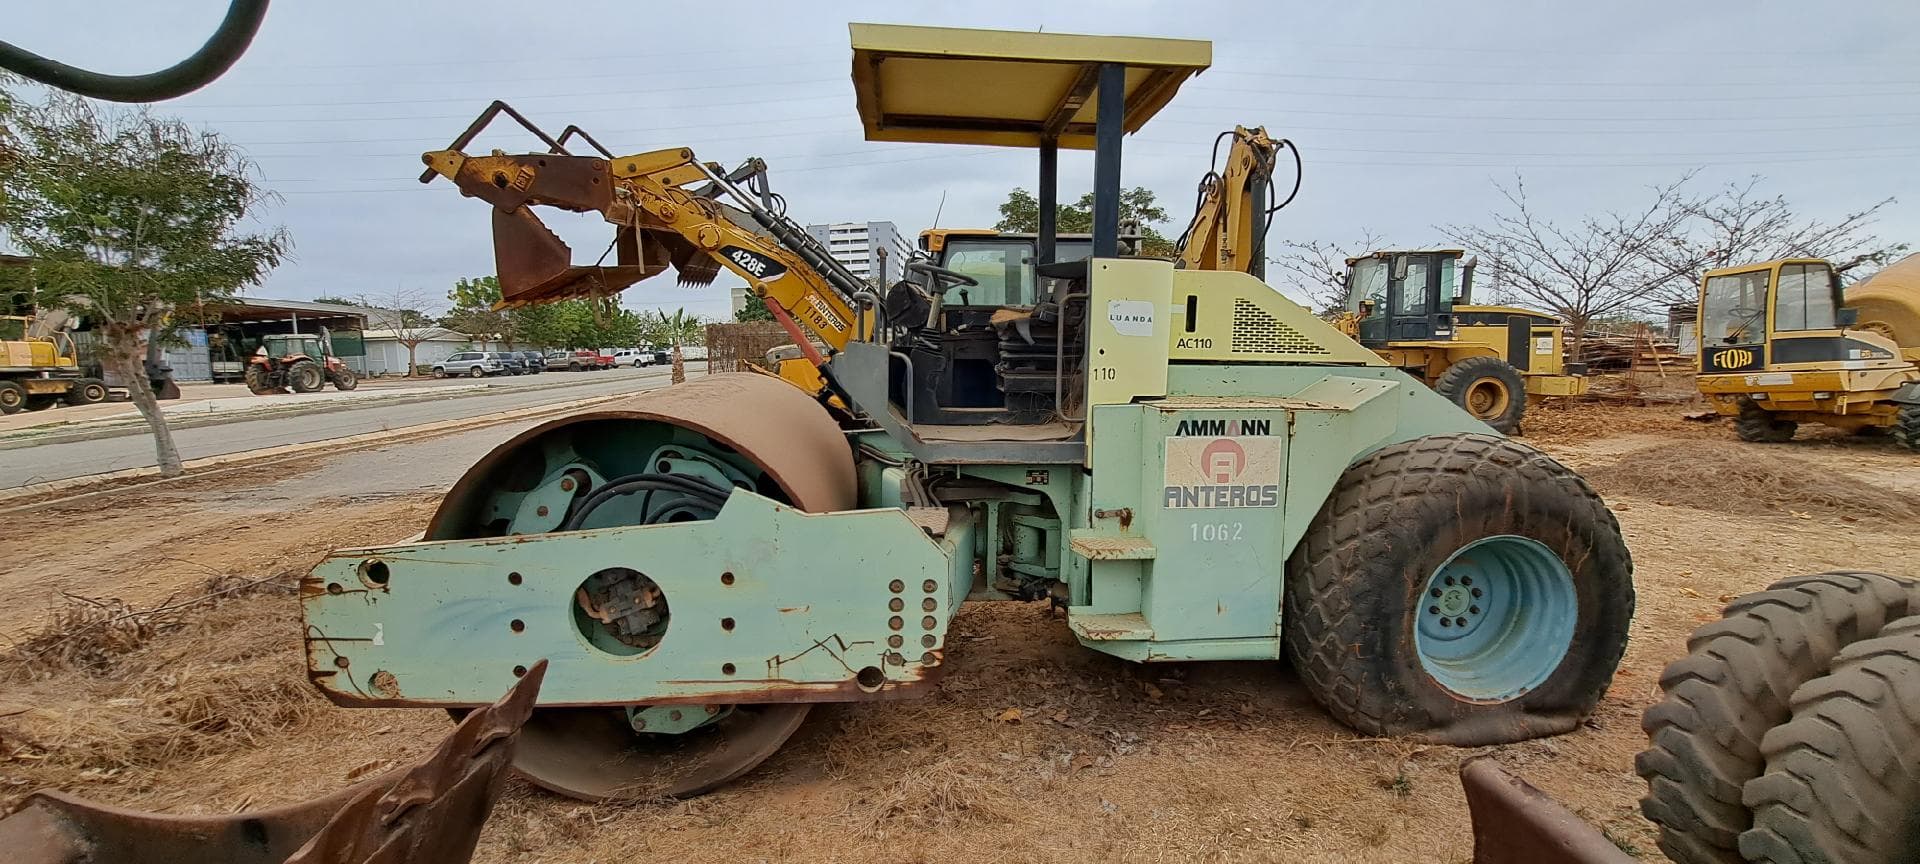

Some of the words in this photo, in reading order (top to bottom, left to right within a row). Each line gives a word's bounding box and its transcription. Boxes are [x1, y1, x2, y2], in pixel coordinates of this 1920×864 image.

[732, 250, 766, 277] 428E
[804, 306, 828, 329] 1183
[815, 300, 846, 332] ANTEROS
[1109, 314, 1153, 323] LUANDA
[1176, 338, 1213, 349] AC110
[1093, 367, 1116, 380] 110
[1175, 419, 1271, 436] AMMANN
[1164, 485, 1278, 508] ANTEROS
[1190, 522, 1243, 542] 1062
